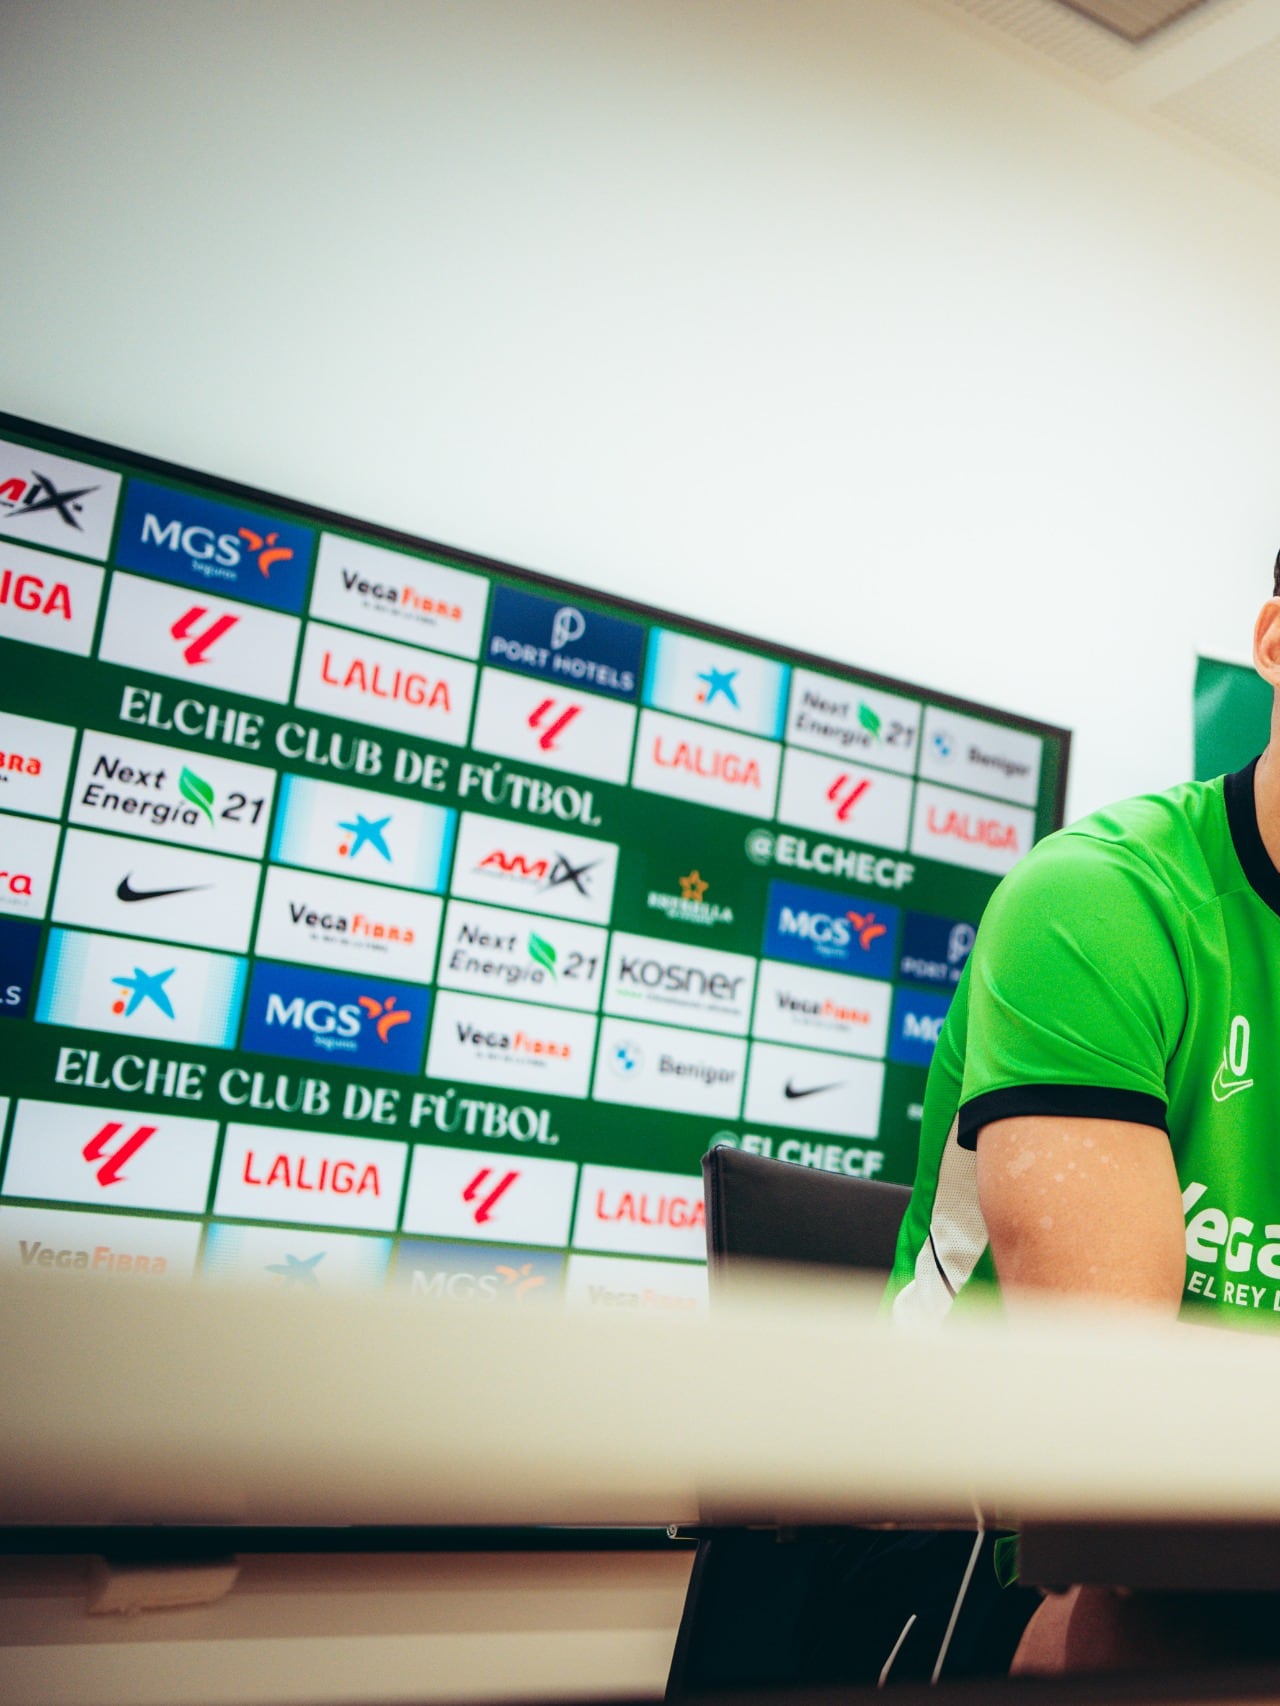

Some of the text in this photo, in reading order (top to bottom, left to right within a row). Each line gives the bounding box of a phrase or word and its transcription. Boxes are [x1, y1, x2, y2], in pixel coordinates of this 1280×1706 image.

[141, 513, 241, 567] MGS
[320, 651, 452, 714] LALIGA
[490, 636, 635, 692] PORT HOTELS
[119, 685, 603, 827] ELCHE CLUB DE FÚTBOL
[885, 721, 915, 749] 21
[92, 755, 167, 790] Next
[653, 736, 761, 789] LALIGA
[221, 792, 265, 825] 21
[927, 805, 1019, 852] LALIGA
[478, 849, 603, 899] AMIX
[745, 827, 915, 891] @ELCHECF
[458, 925, 516, 953] Next
[778, 906, 851, 947] MGS
[563, 952, 597, 981] 21
[265, 993, 362, 1038] MGS
[55, 1046, 560, 1146] ELCHE CLUB DE FÚTBOL
[243, 1149, 381, 1198] LALIGA
[595, 1188, 706, 1231] LALIGA
[409, 1269, 500, 1300] MGS
[1187, 1270, 1217, 1299] EL
[1223, 1280, 1267, 1309] REY
